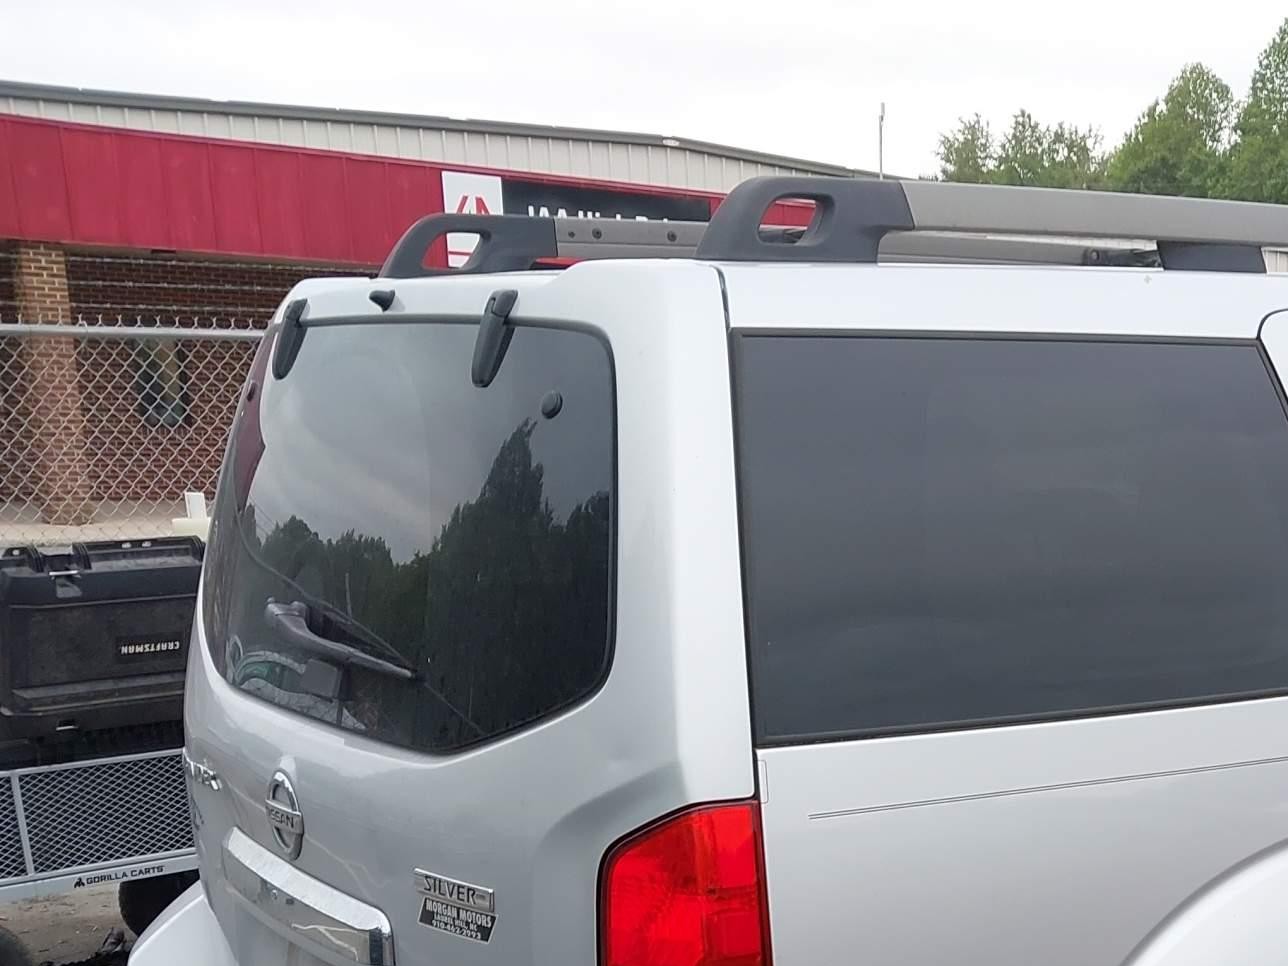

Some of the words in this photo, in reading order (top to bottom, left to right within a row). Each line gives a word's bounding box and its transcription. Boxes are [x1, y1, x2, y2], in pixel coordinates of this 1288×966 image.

[120, 641, 180, 654] CRAFTSMAN
[86, 871, 128, 885] GORILLA
[130, 866, 164, 877] CARTS
[424, 875, 476, 905] SILVER
[426, 899, 457, 918] MORGAN
[460, 909, 492, 928] MOTORS
